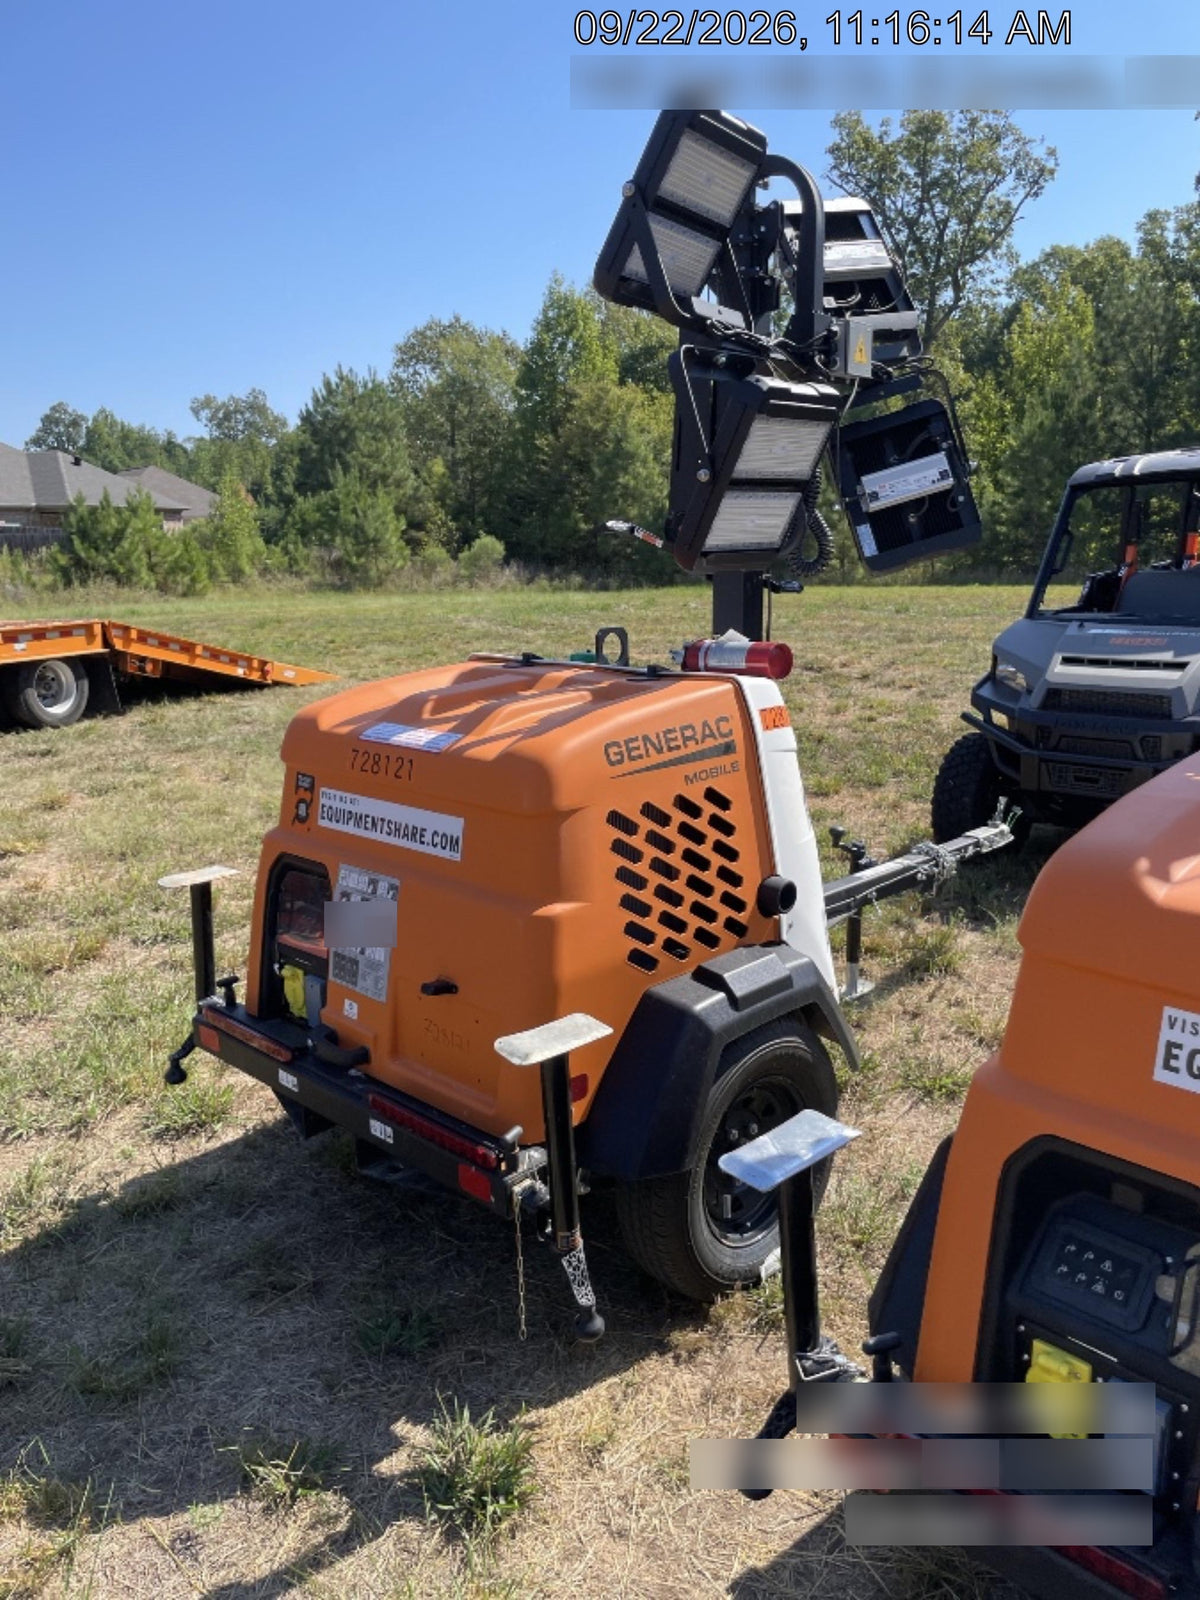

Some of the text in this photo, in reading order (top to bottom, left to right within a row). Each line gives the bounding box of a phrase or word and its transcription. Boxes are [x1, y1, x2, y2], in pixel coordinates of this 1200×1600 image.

[603, 716, 734, 766] GENERAC
[351, 749, 414, 781] 728121
[684, 760, 740, 786] MOBILE
[320, 803, 461, 854] EQUIPMENTSHARE.COM
